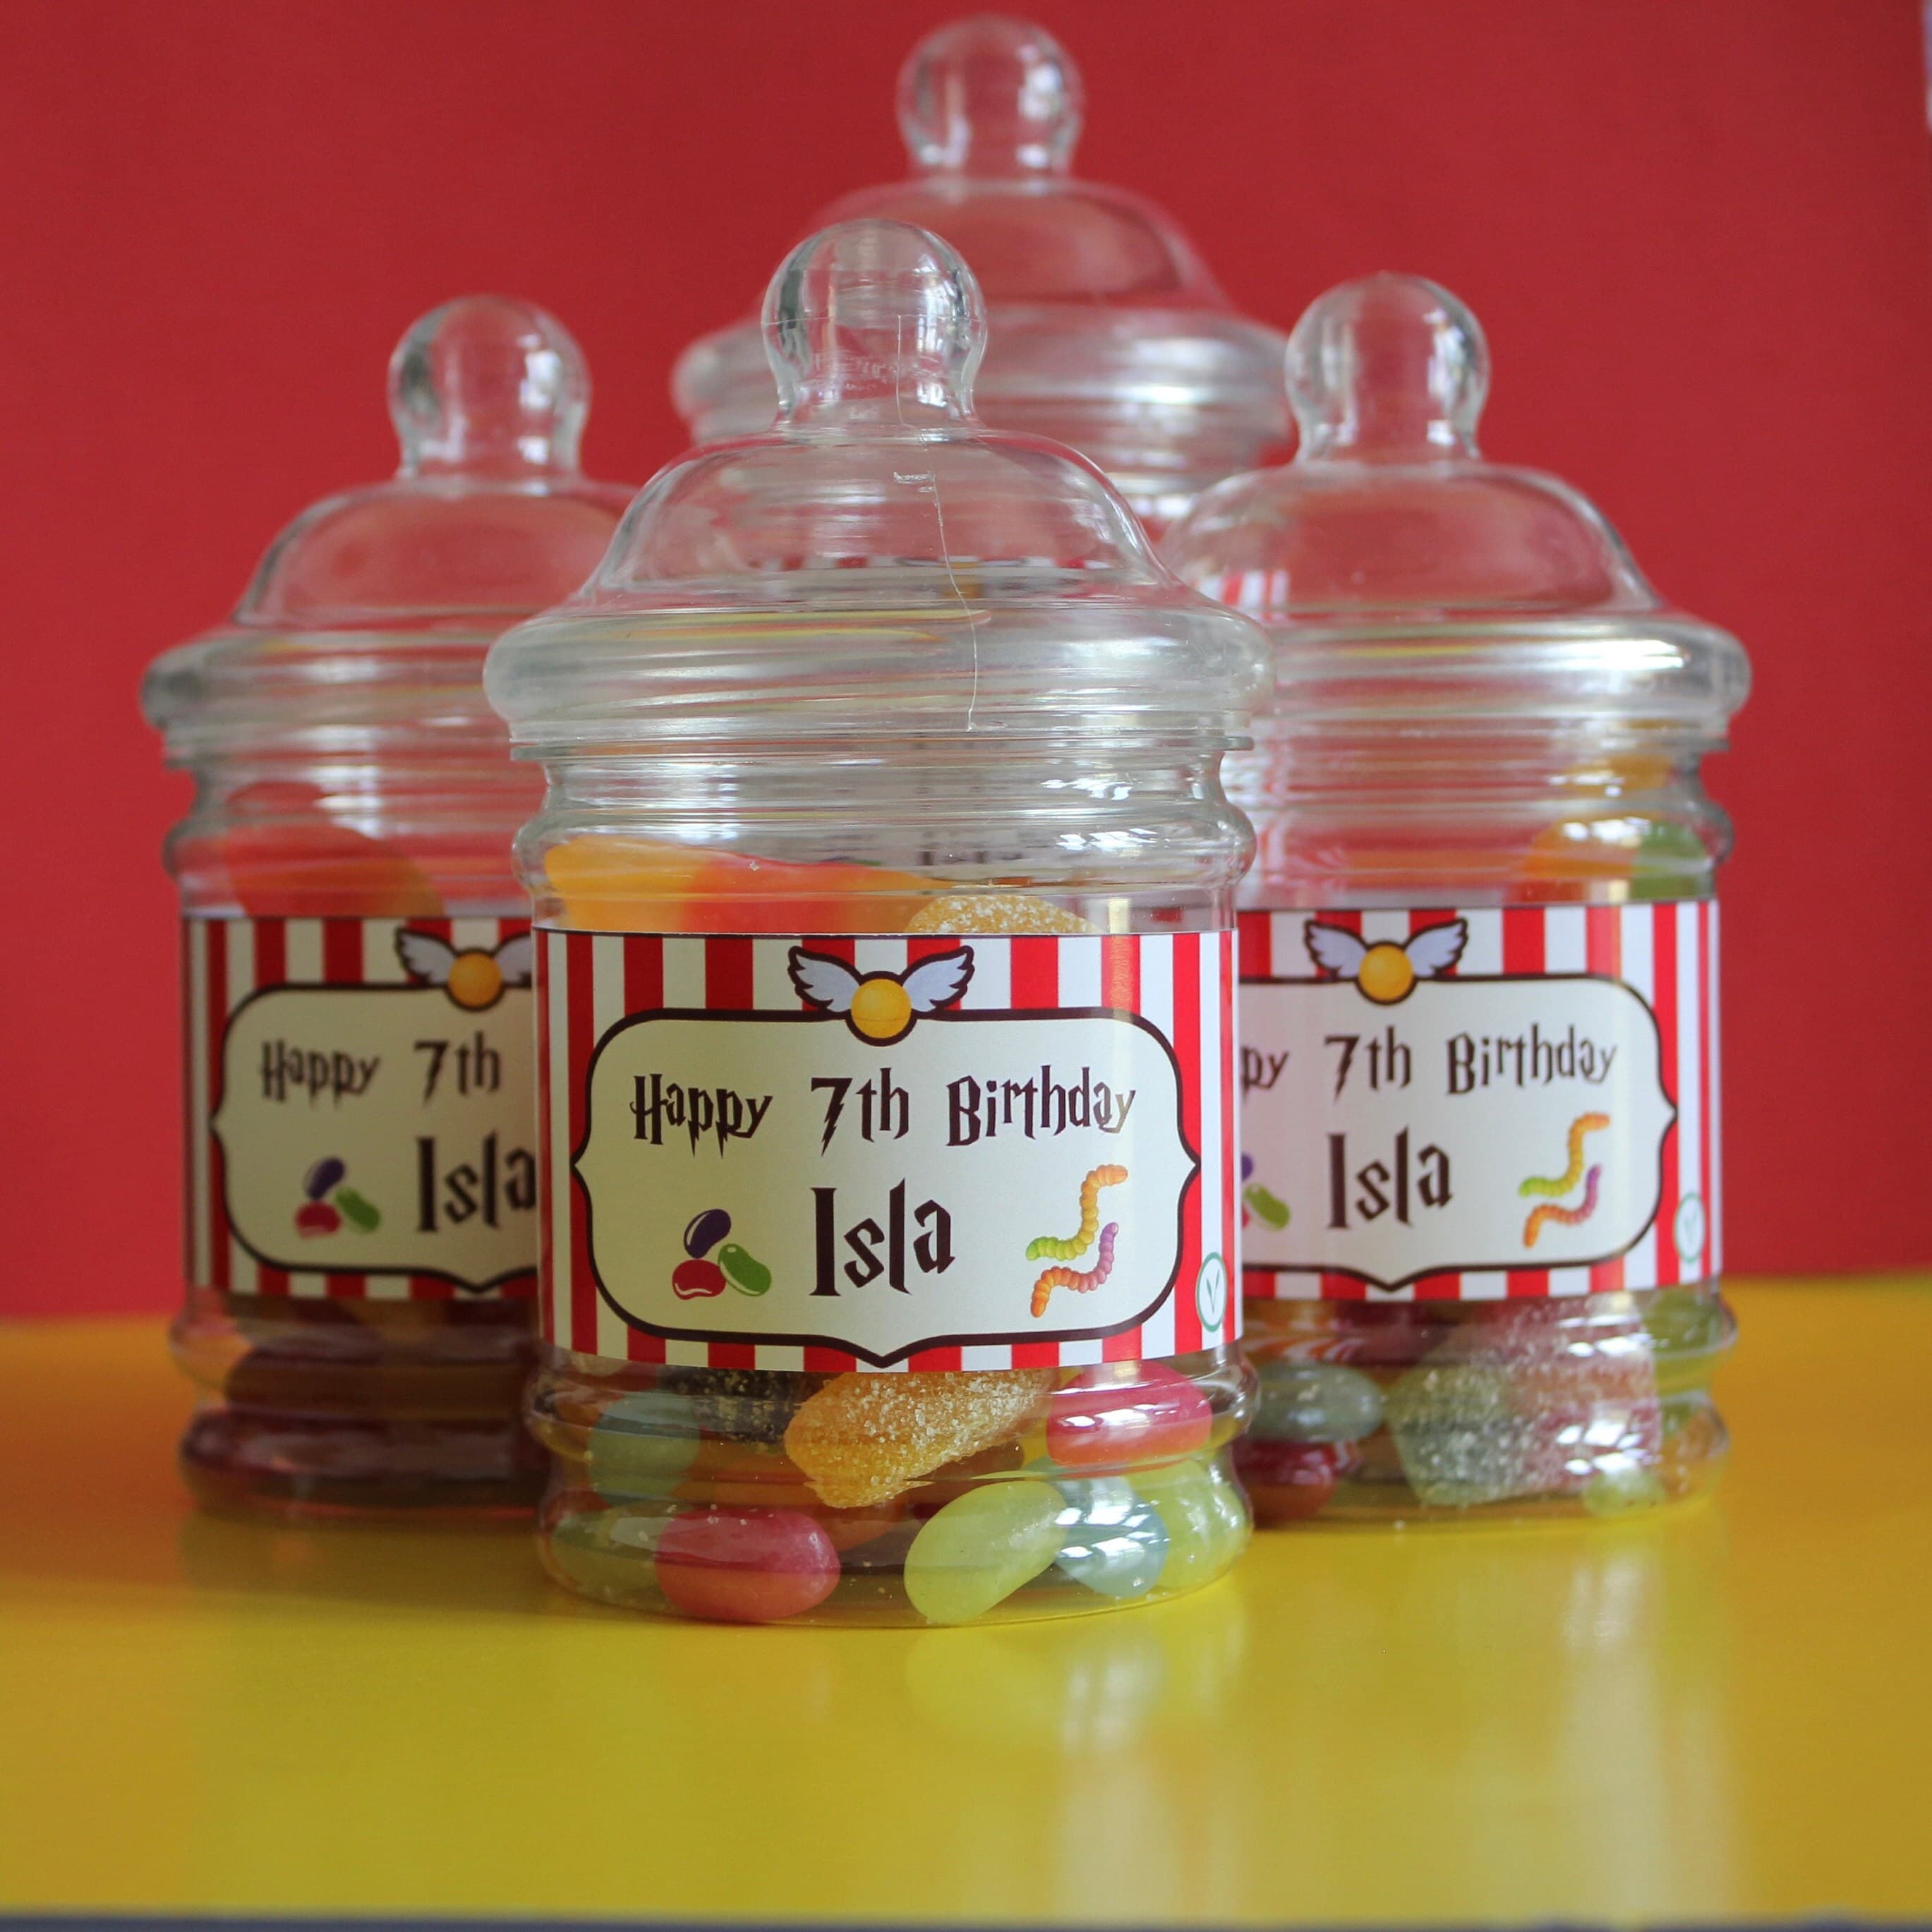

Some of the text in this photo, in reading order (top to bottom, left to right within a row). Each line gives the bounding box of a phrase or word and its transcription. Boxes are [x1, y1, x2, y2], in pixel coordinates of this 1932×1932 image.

[260, 1030, 503, 1105] Happy 7th
[1324, 1025, 1412, 1102] 7th
[1445, 1022, 1617, 1097] Birthday
[629, 1065, 1137, 1159] Happy 7th Birthday
[416, 1129, 536, 1234] Isla
[1327, 1126, 1453, 1231] Isla
[808, 1178, 956, 1298] Isla
